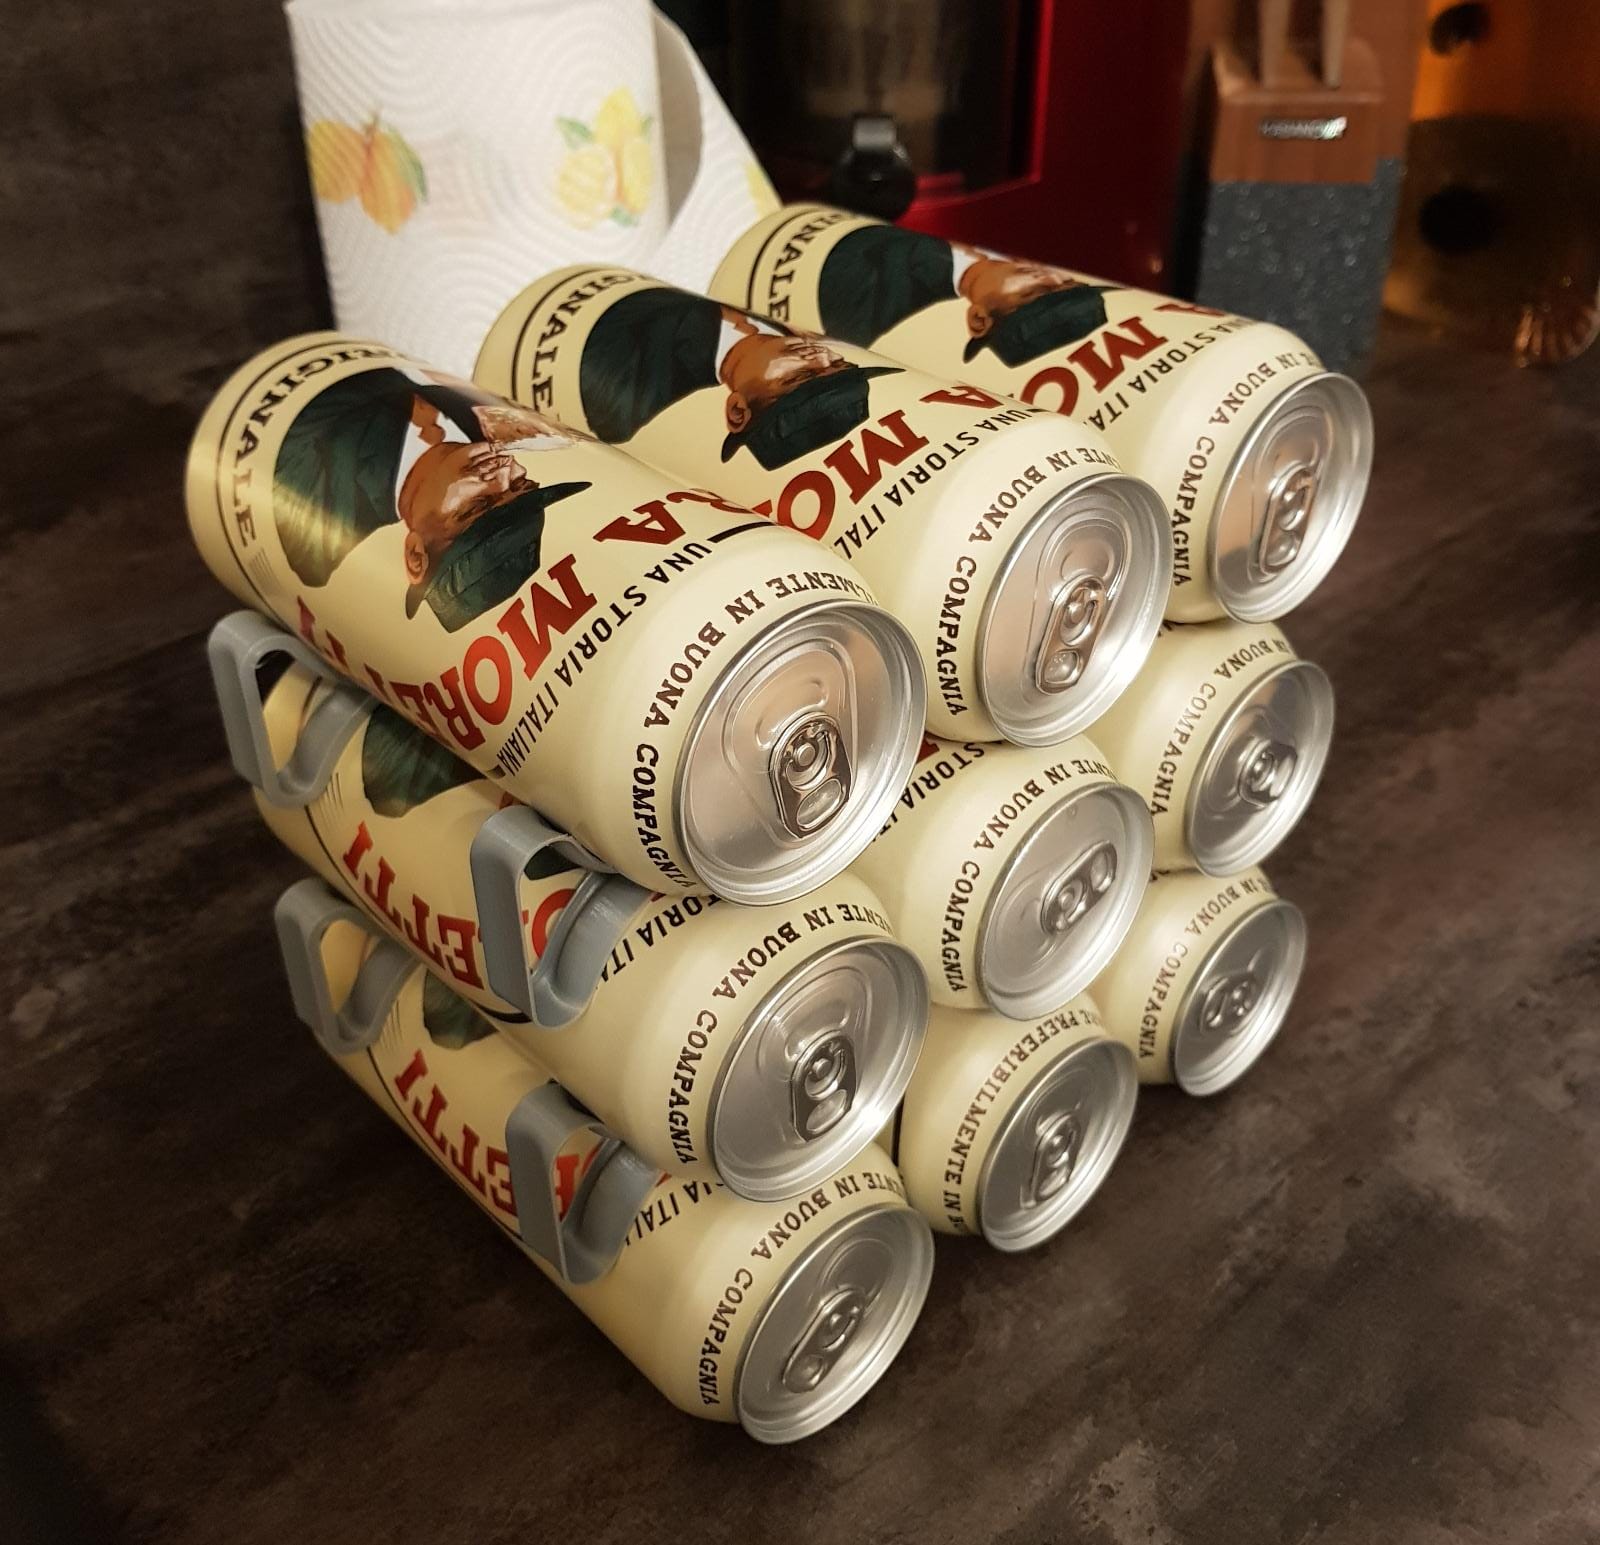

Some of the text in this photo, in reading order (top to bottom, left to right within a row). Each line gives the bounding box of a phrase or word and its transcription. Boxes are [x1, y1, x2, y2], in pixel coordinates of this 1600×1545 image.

[532, 275, 643, 413] GINALE
[1128, 332, 1217, 394] STORIA
[1088, 393, 1130, 432] ITA
[1209, 362, 1277, 426] BUONA
[884, 431, 979, 507] STORIA
[1046, 448, 1077, 474] IN
[833, 503, 887, 560] ITAL
[968, 463, 1047, 543] BUONA
[1172, 436, 1215, 587] COMPAGNIA
[724, 589, 766, 625] IN
[936, 556, 977, 716] COMPAGNIA
[496, 542, 712, 777] UNA STORIA ITALIANA
[644, 621, 727, 729] BUONA
[1214, 640, 1273, 680] BUONA
[900, 742, 985, 809] STORIA
[1043, 763, 1076, 786] IN
[1151, 682, 1217, 816] COMPAGNIA
[632, 743, 697, 888] COMPAGNIA
[973, 779, 1044, 851] BUONA
[803, 906, 835, 931] IN
[942, 860, 980, 992] COMPAGNIA
[1184, 885, 1240, 936] BUONA
[712, 921, 802, 1000] BUONA
[1139, 943, 1188, 1059] COMPAGNIA
[668, 1009, 718, 1164] COMPAGNIA
[943, 1010, 1082, 1216] PREFERIBILMENTE IN
[751, 1188, 832, 1260] BUONA
[833, 1175, 861, 1199] IN
[699, 1268, 753, 1406] COMPAGNIA
